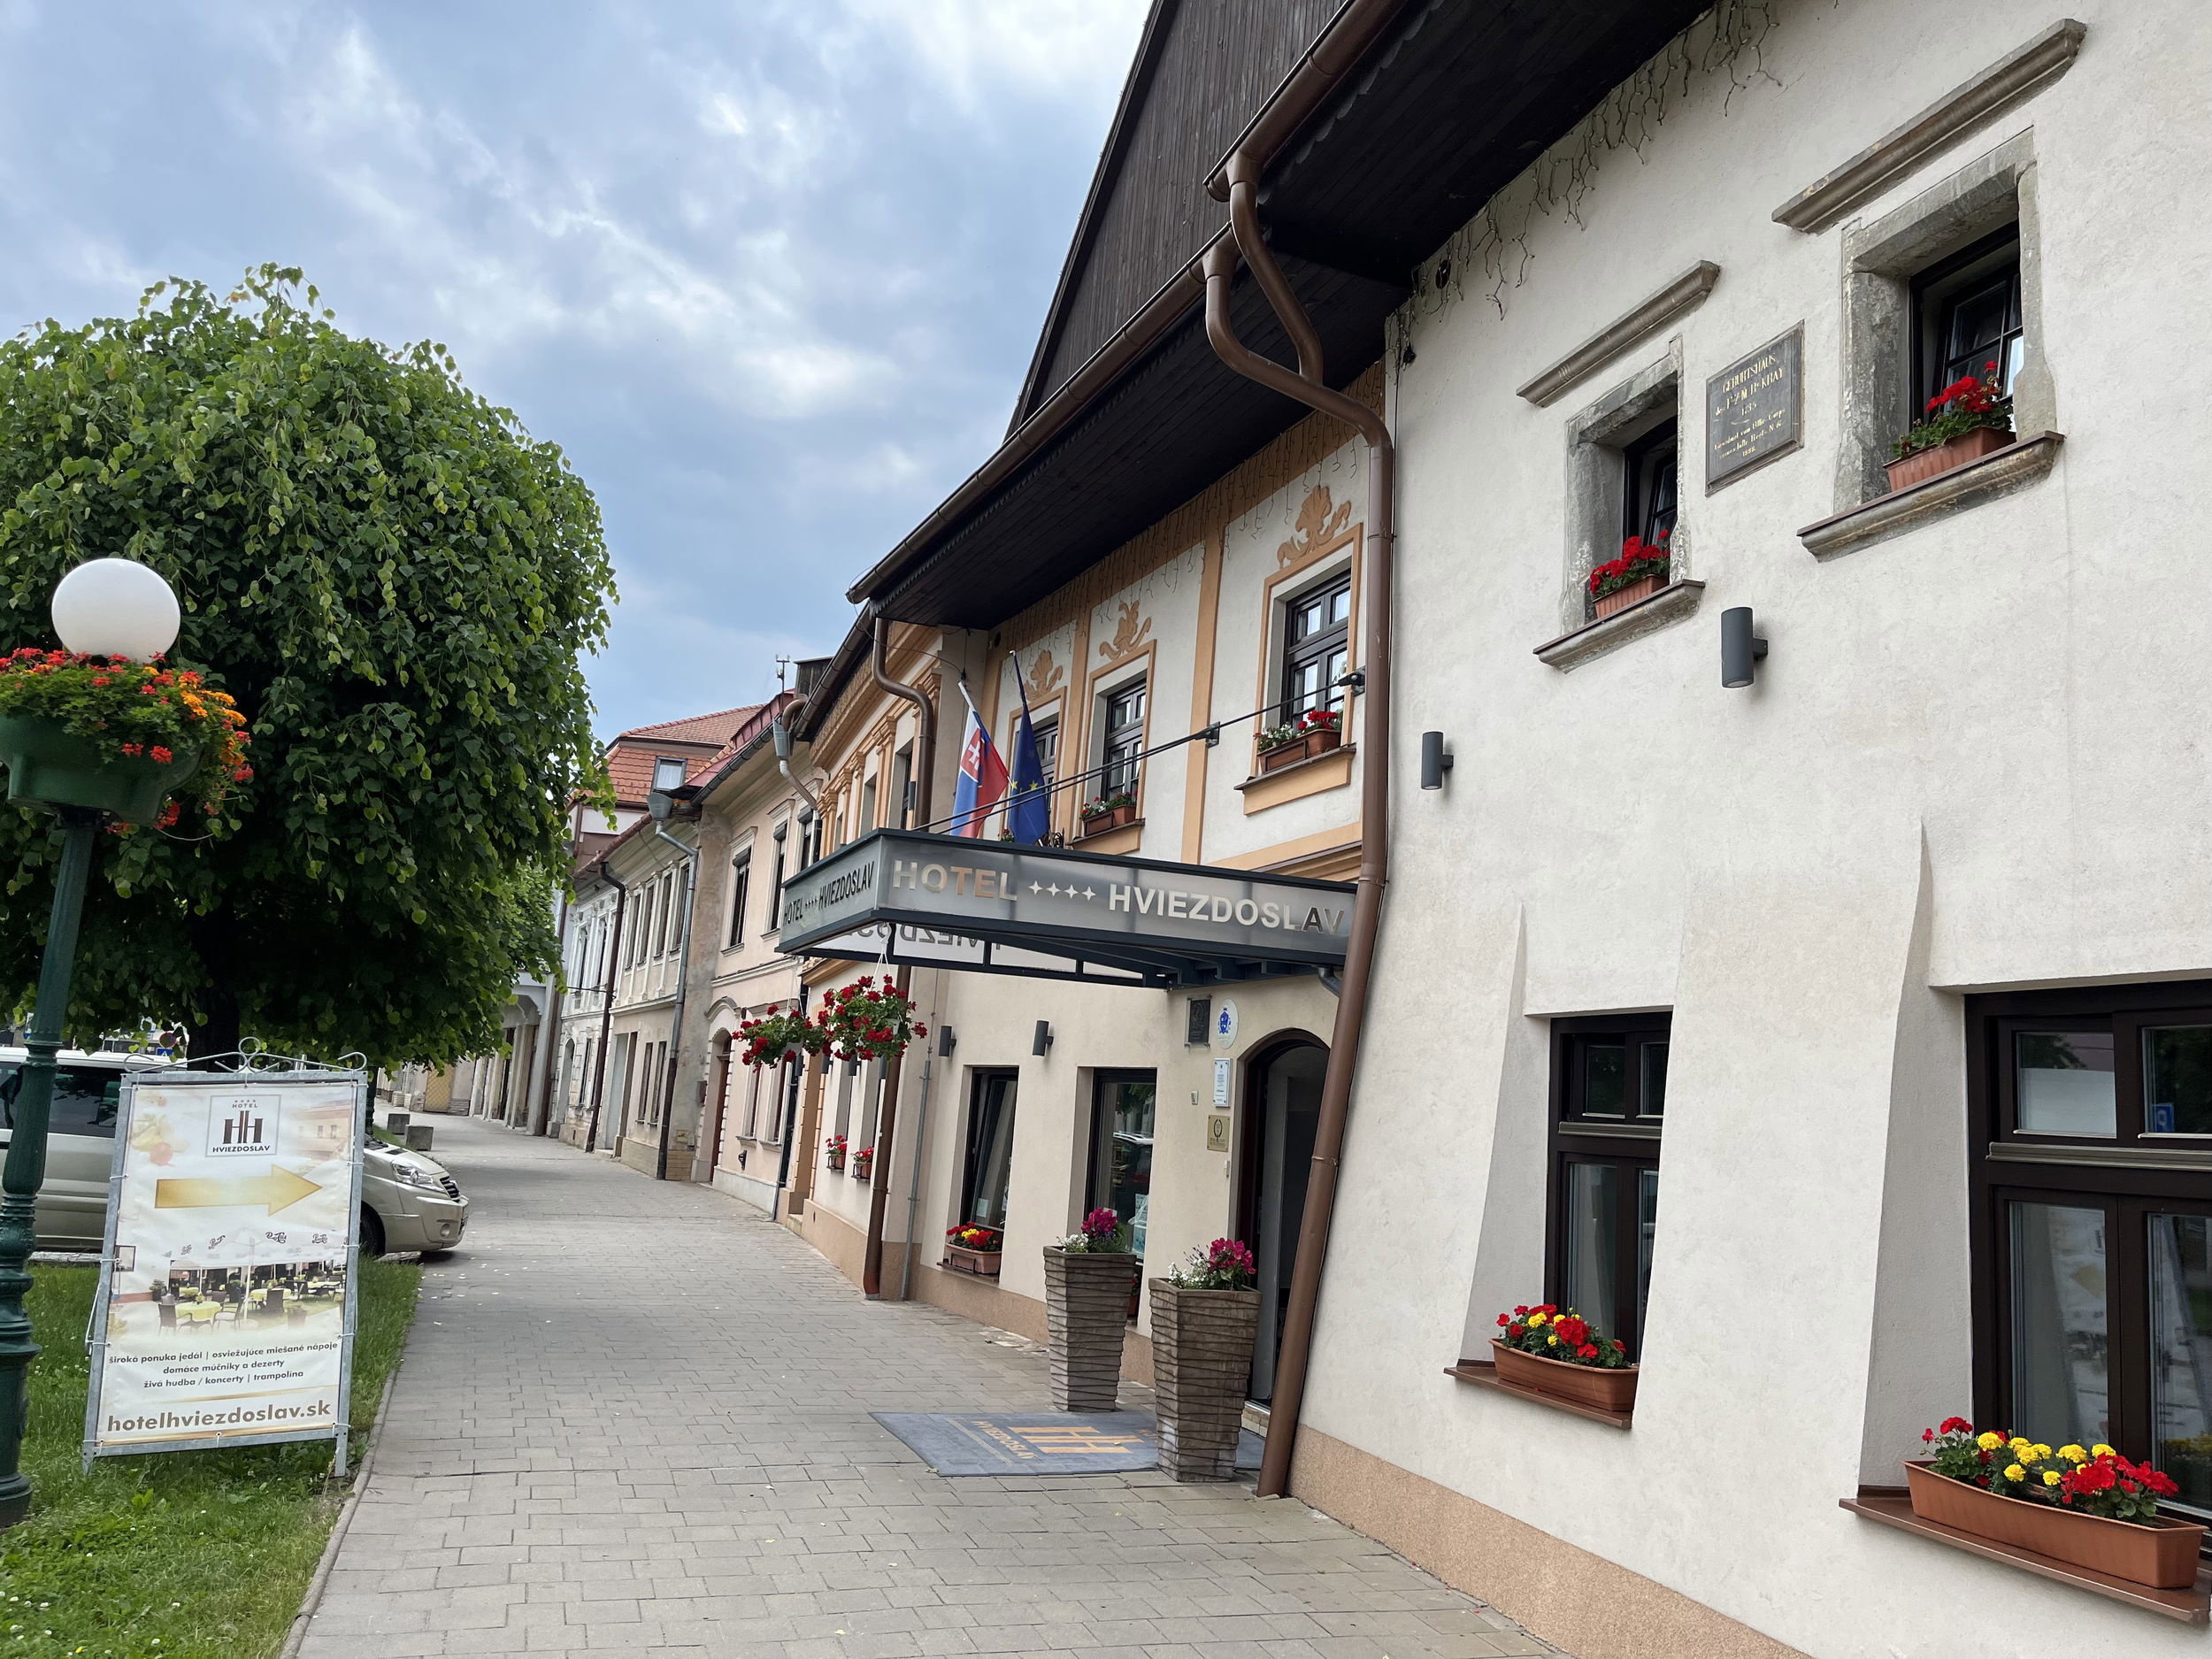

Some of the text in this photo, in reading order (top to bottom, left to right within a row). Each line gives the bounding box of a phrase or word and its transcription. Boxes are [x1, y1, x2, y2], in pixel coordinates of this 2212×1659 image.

[783, 860, 874, 926] HOTEL HVIEZDOSLAV
[892, 859, 1345, 934] HOTEL HVIEZDOSLAV
[109, 1356, 139, 1364] široká
[141, 1354, 176, 1364] ponuka
[178, 1351, 203, 1363] jedál
[212, 1347, 264, 1359] osviežujúce
[266, 1344, 304, 1355] miešané
[306, 1341, 338, 1352] nápoje
[143, 1379, 163, 1388] živá
[165, 1378, 196, 1387] hudba
[204, 1374, 244, 1385] koncerty
[253, 1370, 303, 1381] trampolína
[163, 1365, 200, 1375] domáce
[202, 1362, 240, 1372] múčniky
[250, 1359, 285, 1369] dezerty
[107, 1400, 331, 1432] hotelhviezdoslav.sk
